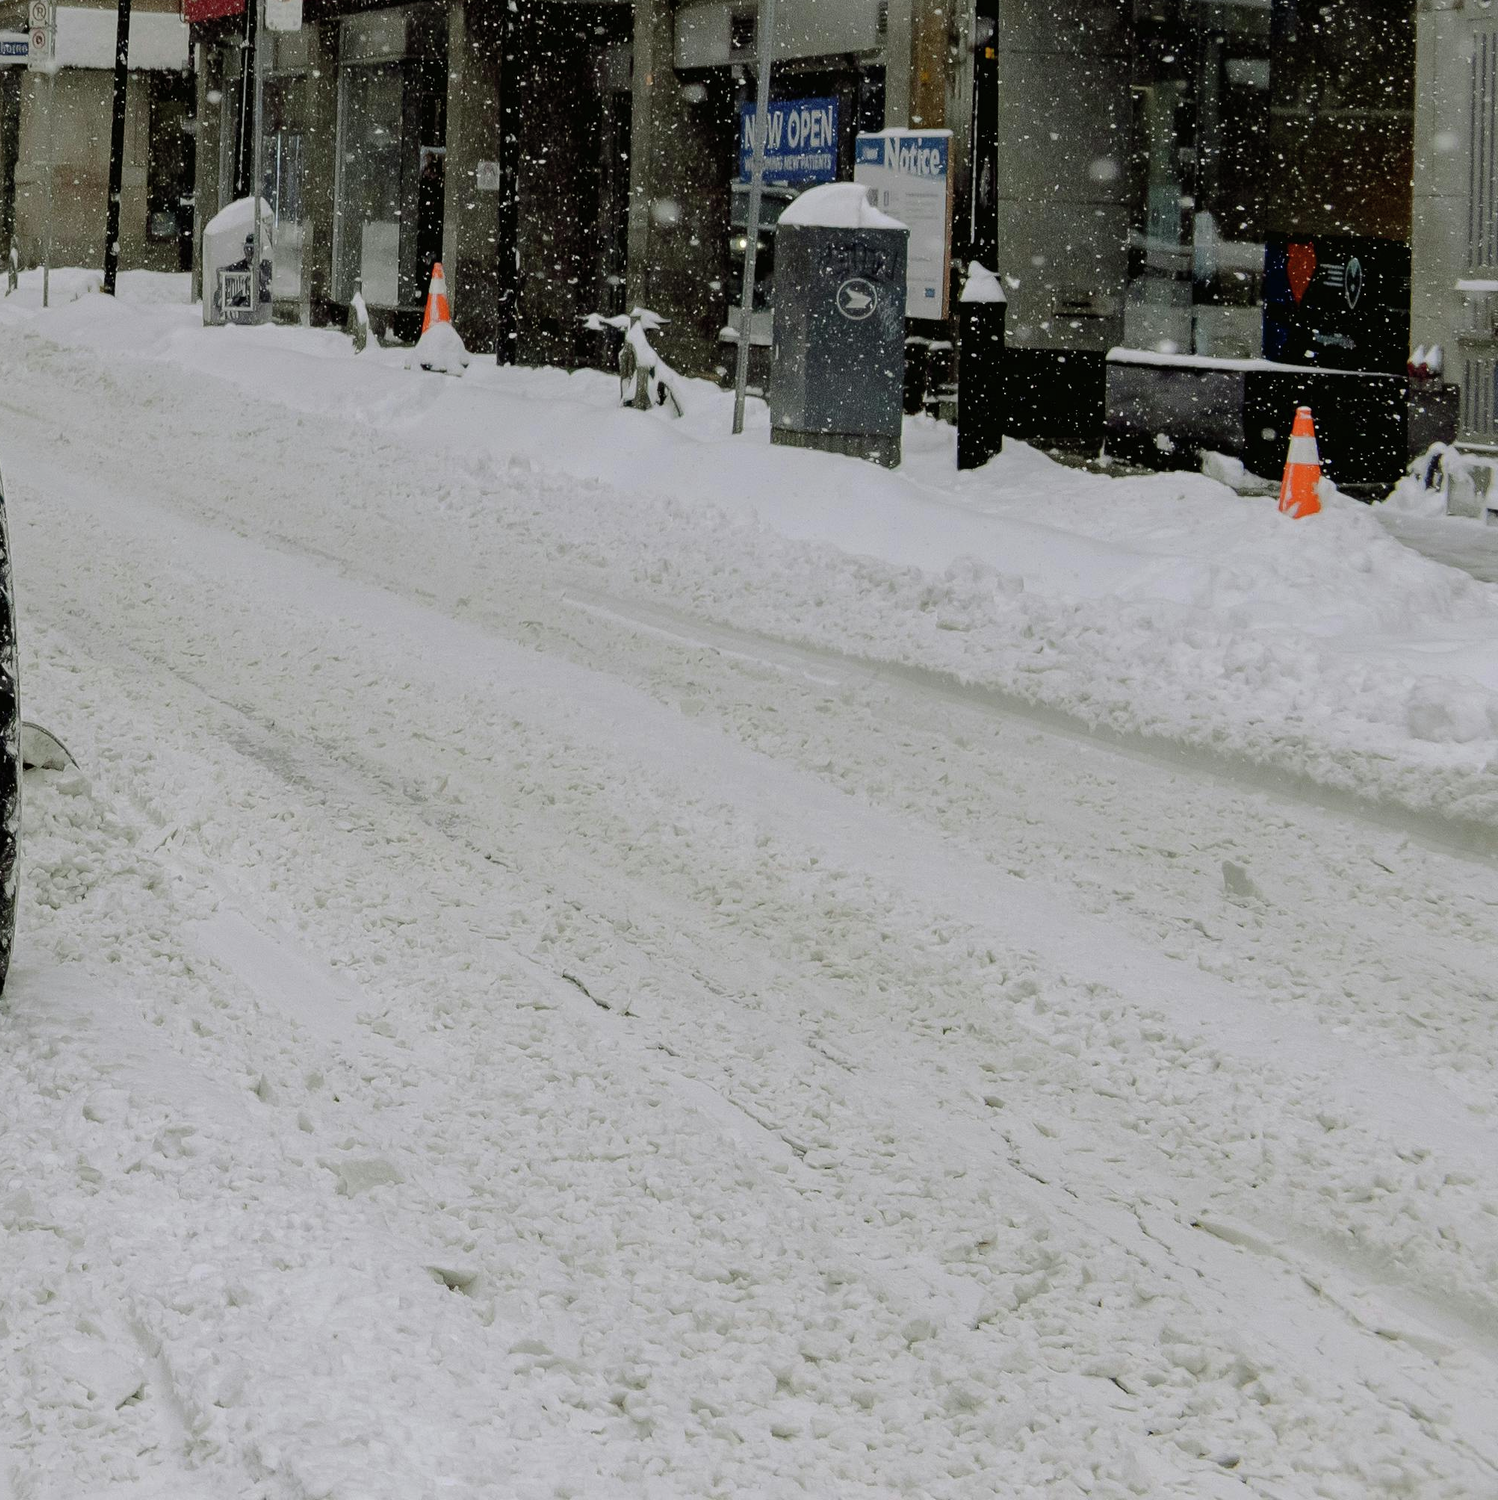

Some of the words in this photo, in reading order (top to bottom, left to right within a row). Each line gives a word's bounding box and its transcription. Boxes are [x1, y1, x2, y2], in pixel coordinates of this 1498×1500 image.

[744, 112, 784, 151] NW
[787, 108, 834, 149] OPEN
[884, 136, 941, 176] Notice
